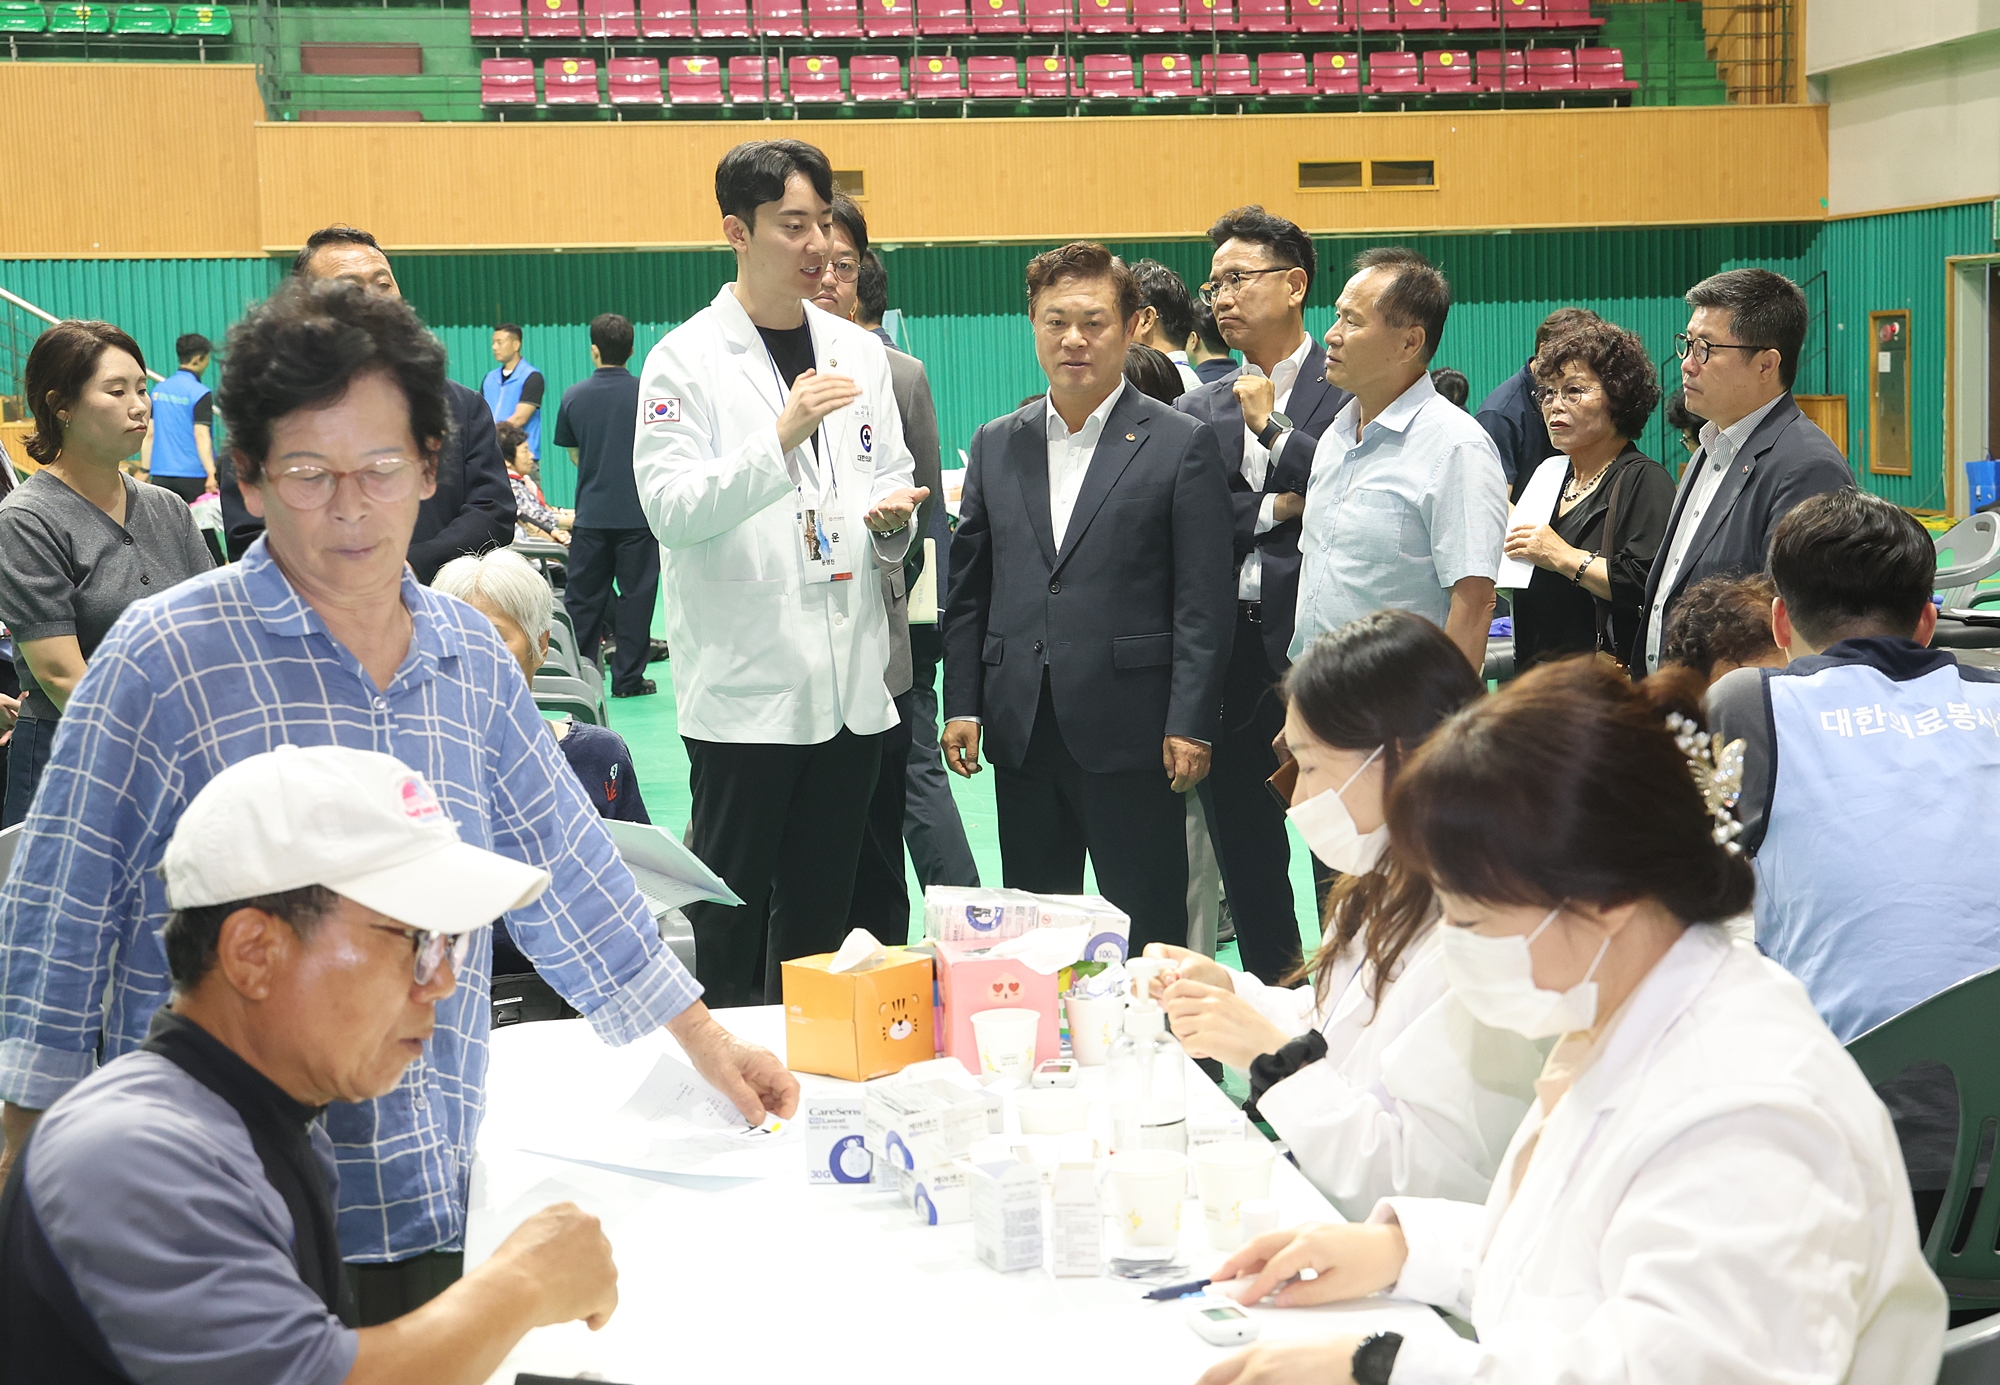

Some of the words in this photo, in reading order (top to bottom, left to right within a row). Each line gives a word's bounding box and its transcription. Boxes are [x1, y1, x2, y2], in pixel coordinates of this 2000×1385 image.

[1819, 701, 2000, 740] 대한의료봉사
[808, 1106, 861, 1116] CareSens
[810, 1169, 831, 1179] 30G
